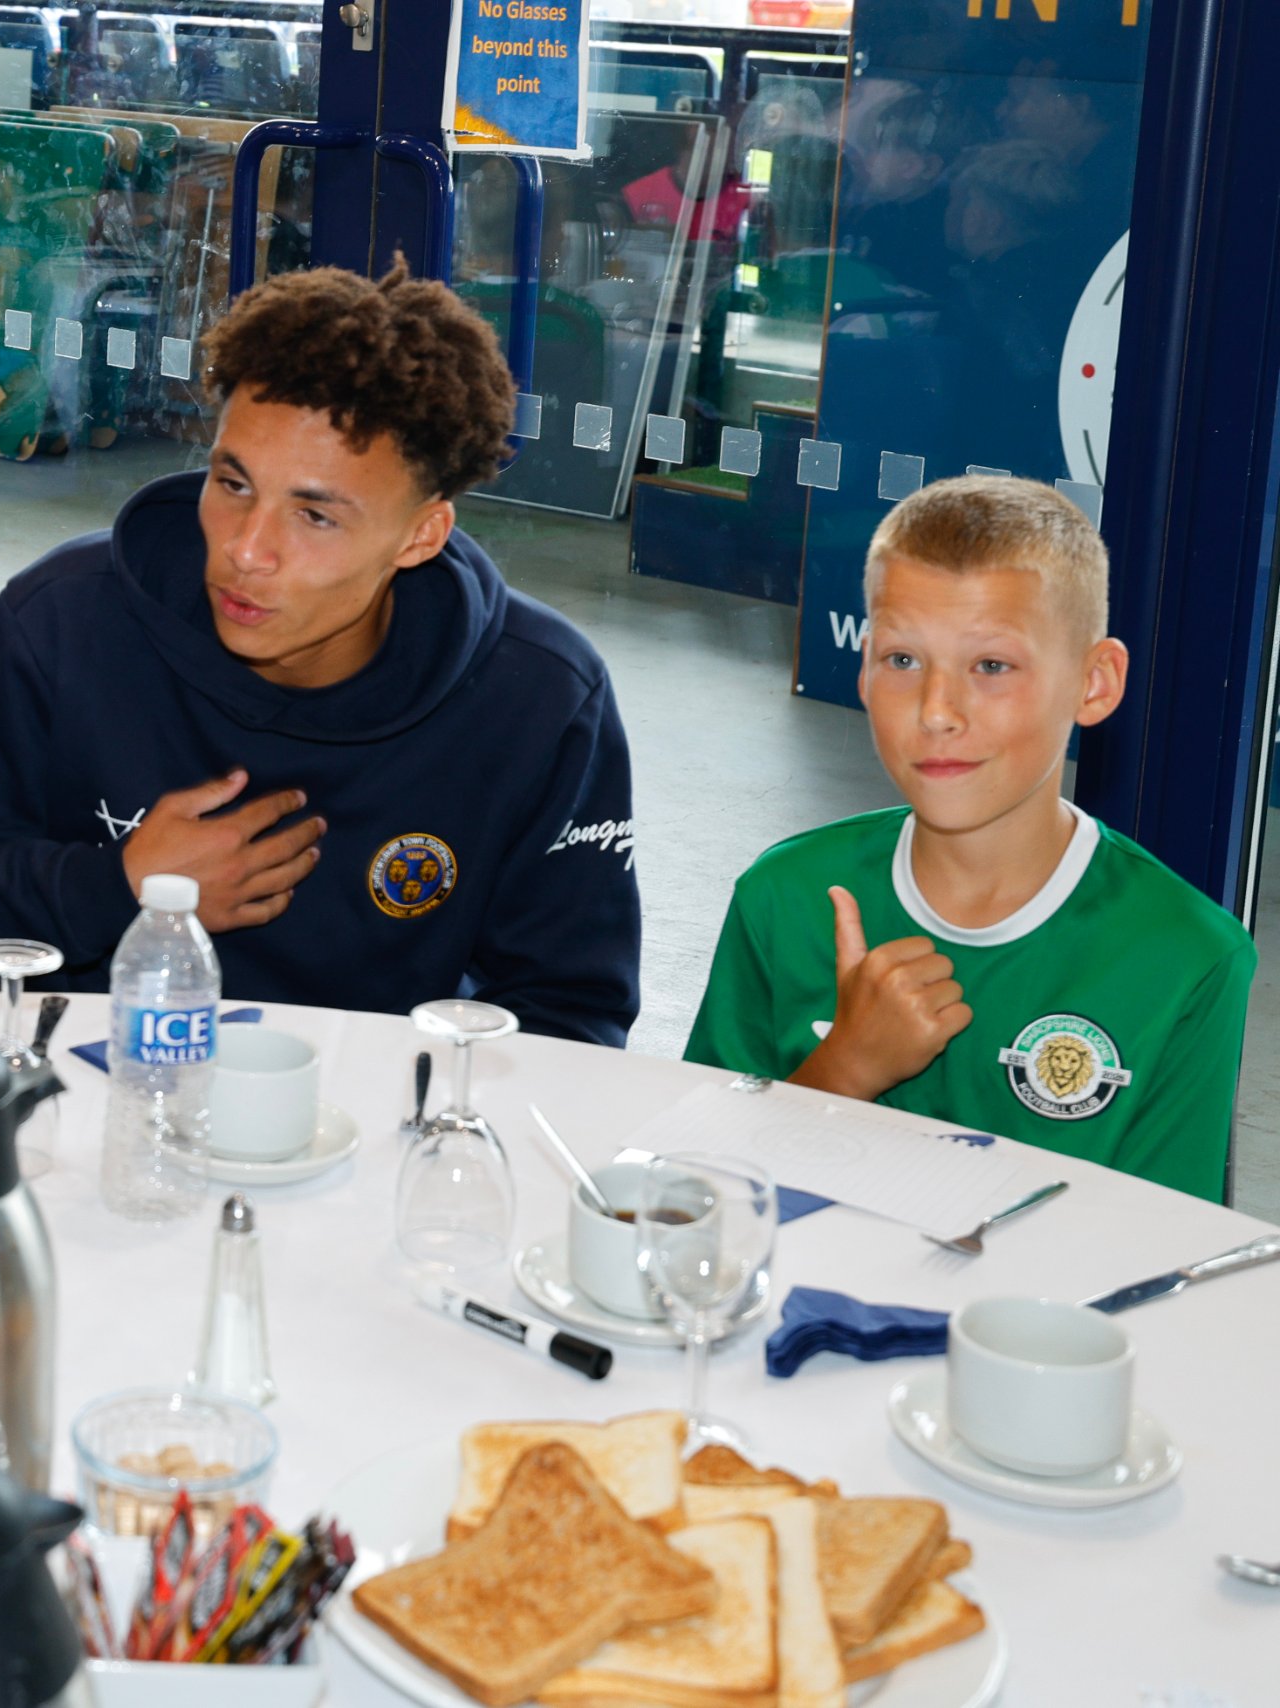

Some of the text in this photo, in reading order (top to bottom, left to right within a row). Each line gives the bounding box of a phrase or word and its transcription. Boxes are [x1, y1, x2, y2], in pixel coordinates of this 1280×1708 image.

[479, 1, 567, 21] No Glasses
[472, 36, 568, 58] beyond this
[497, 75, 541, 95] point
[141, 1010, 209, 1046] ICE
